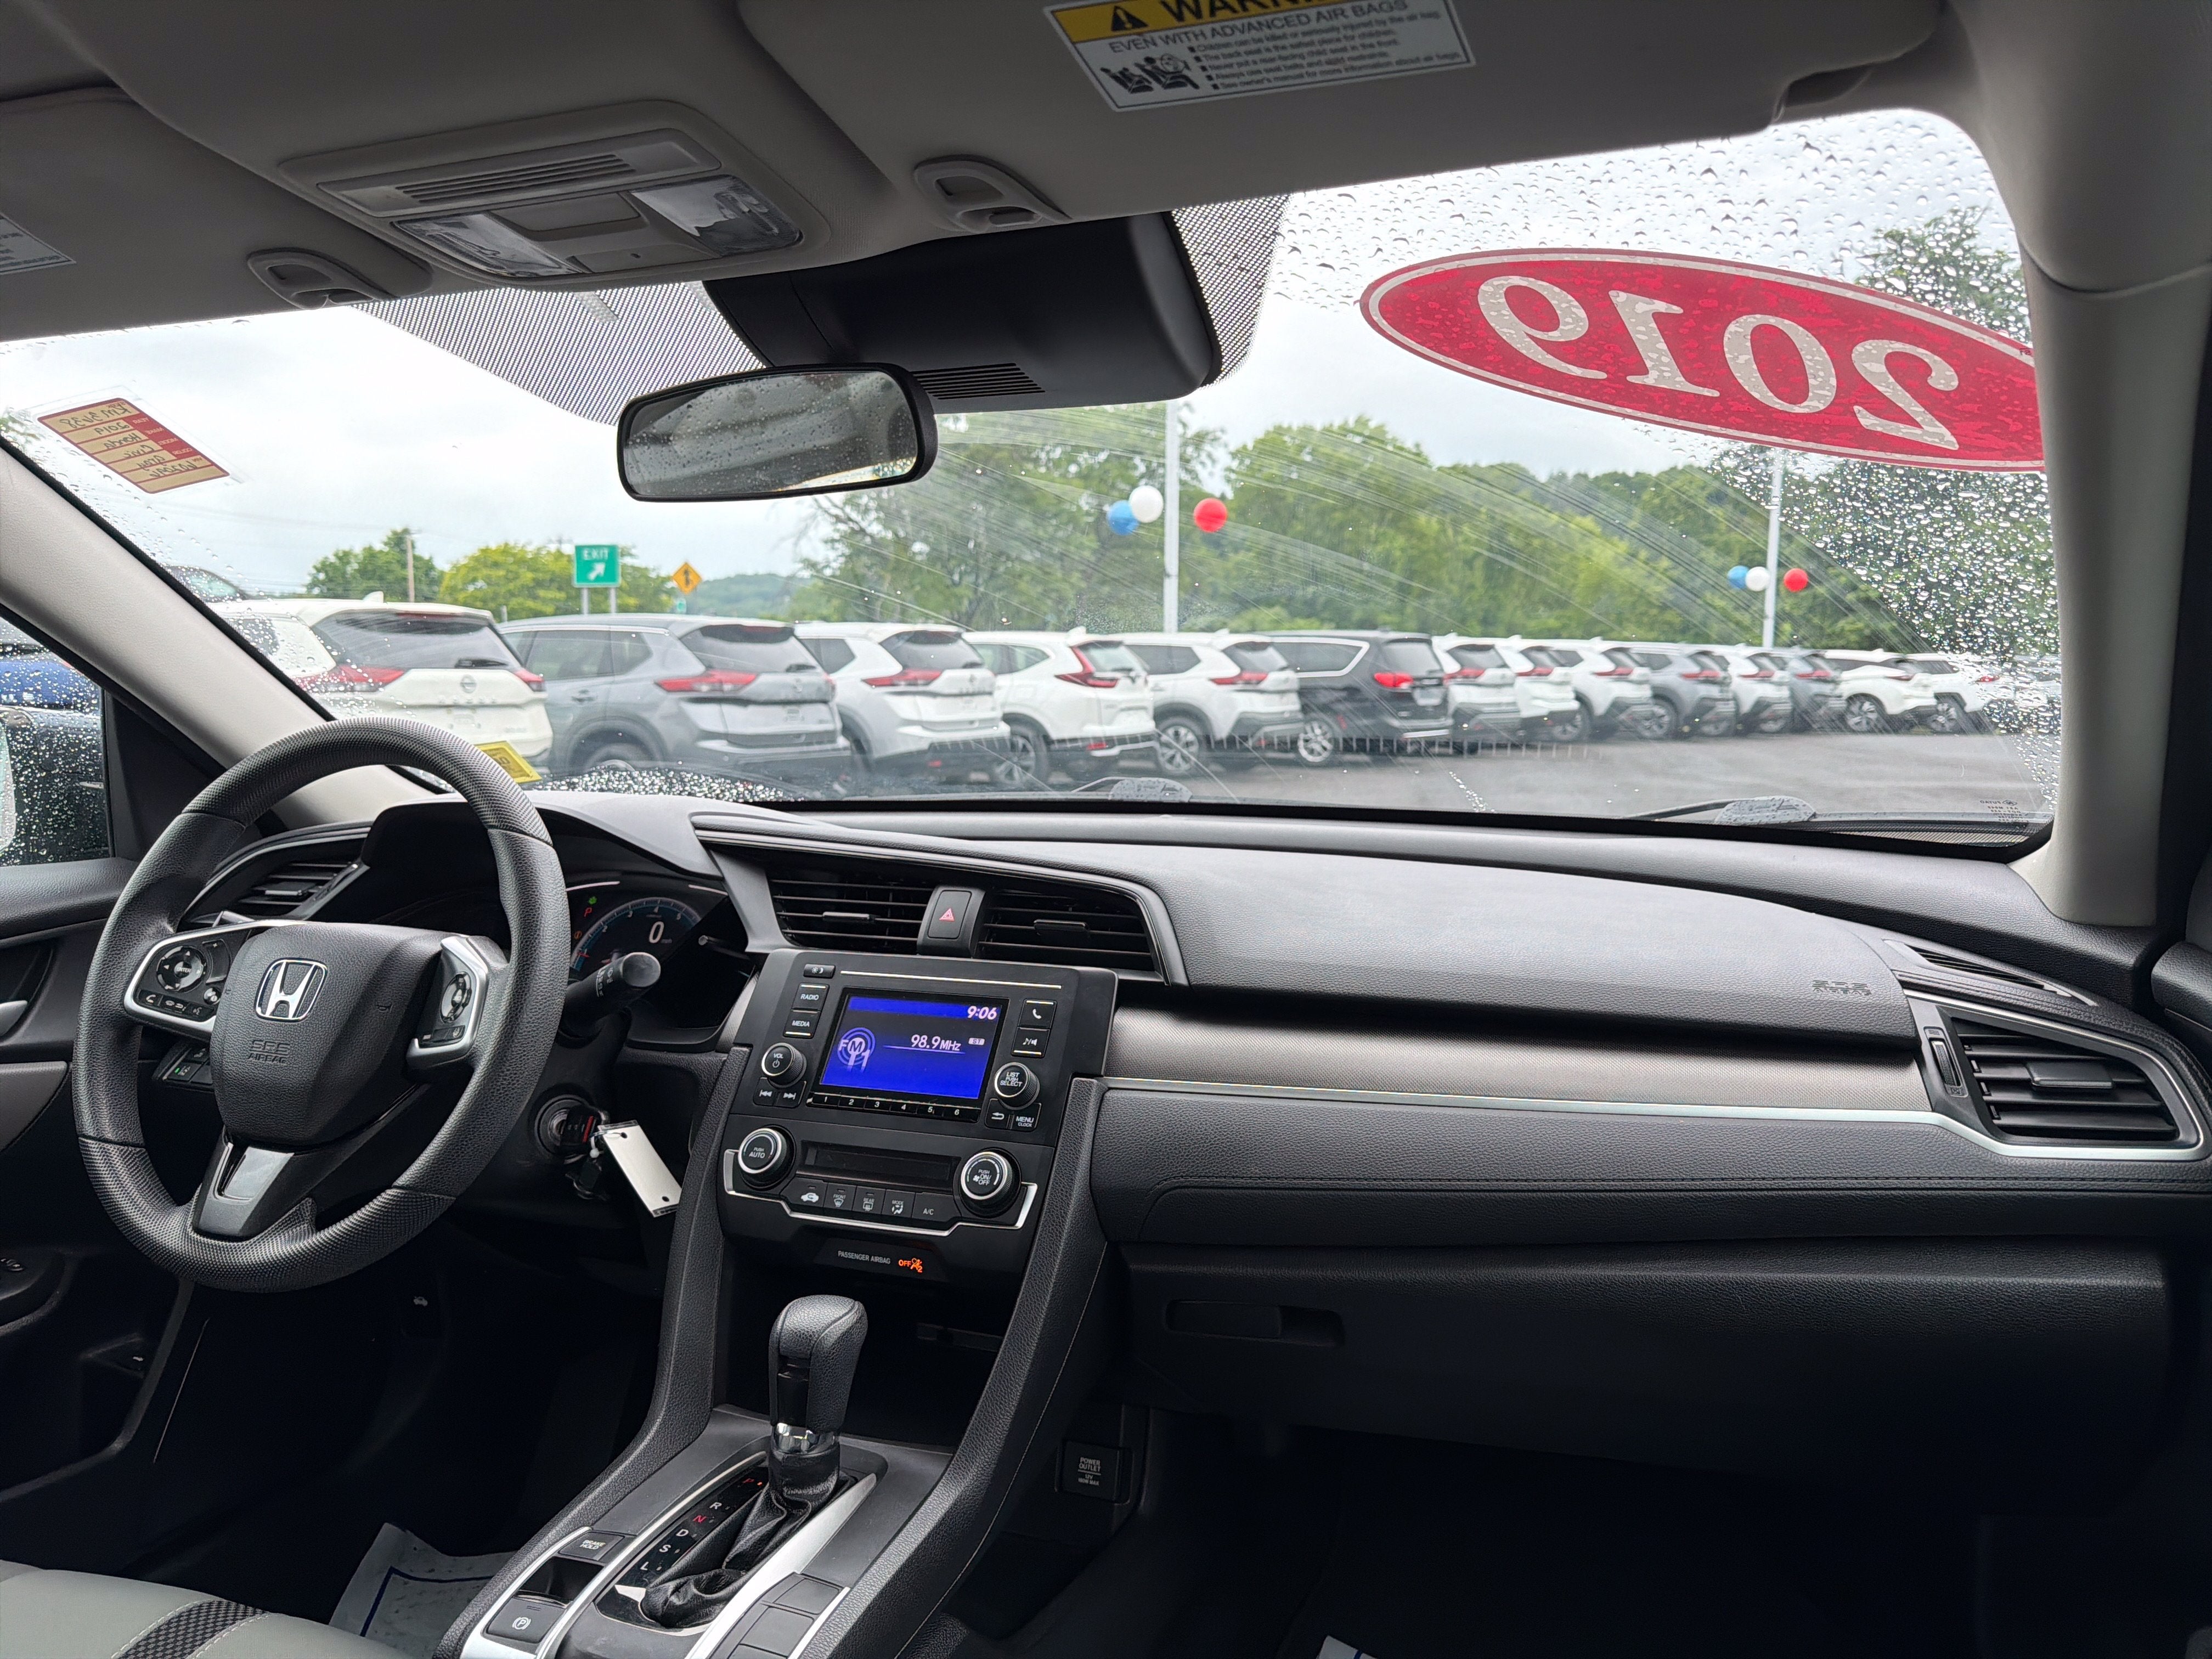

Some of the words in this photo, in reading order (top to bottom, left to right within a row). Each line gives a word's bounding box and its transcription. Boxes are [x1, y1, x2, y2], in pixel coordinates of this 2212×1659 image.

[1107, 36, 1158, 53] EVEN
[1158, 28, 1208, 45] WITH
[1206, 12, 1313, 38] ADVANCED
[1311, 6, 1349, 22] AIR
[1350, 0, 1409, 16] BAGS
[583, 548, 608, 560] EXIT
[648, 921, 665, 944] 0
[967, 1006, 997, 1020] 9:06
[251, 1040, 290, 1052] SRS
[246, 1053, 287, 1064] AIRBAG
[838, 1250, 870, 1261] PASSENGER
[871, 1256, 891, 1265] AIRBAG
[1080, 1457, 1101, 1465] POWER
[1079, 1463, 1101, 1472] OUTLET
[693, 1515, 708, 1523] N
[659, 1544, 672, 1553] S
[640, 1561, 649, 1570] L
